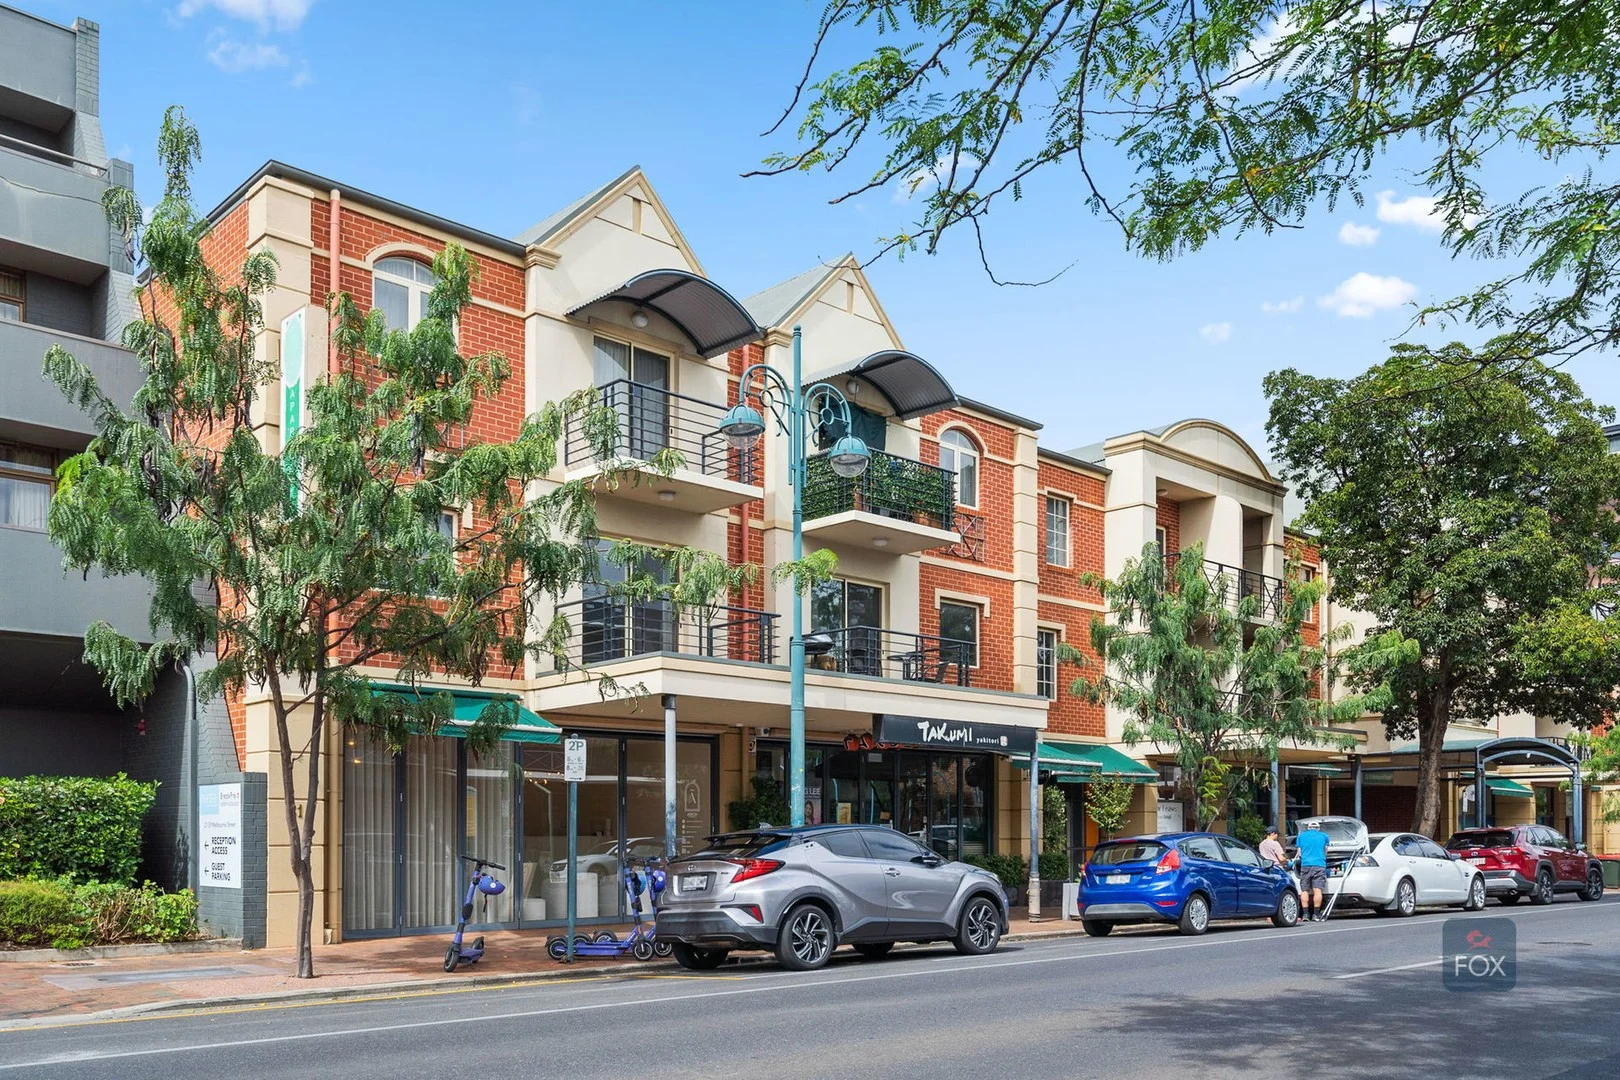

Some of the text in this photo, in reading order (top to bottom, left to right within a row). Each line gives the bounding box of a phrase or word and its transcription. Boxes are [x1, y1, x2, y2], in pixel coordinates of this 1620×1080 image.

[976, 736, 1000, 745] yakitori
[569, 740, 584, 751] 2P
[212, 836, 236, 845] RECEPTION
[212, 846, 228, 854] ACCESS
[212, 862, 226, 871] GUEST
[211, 872, 231, 881] PARKING
